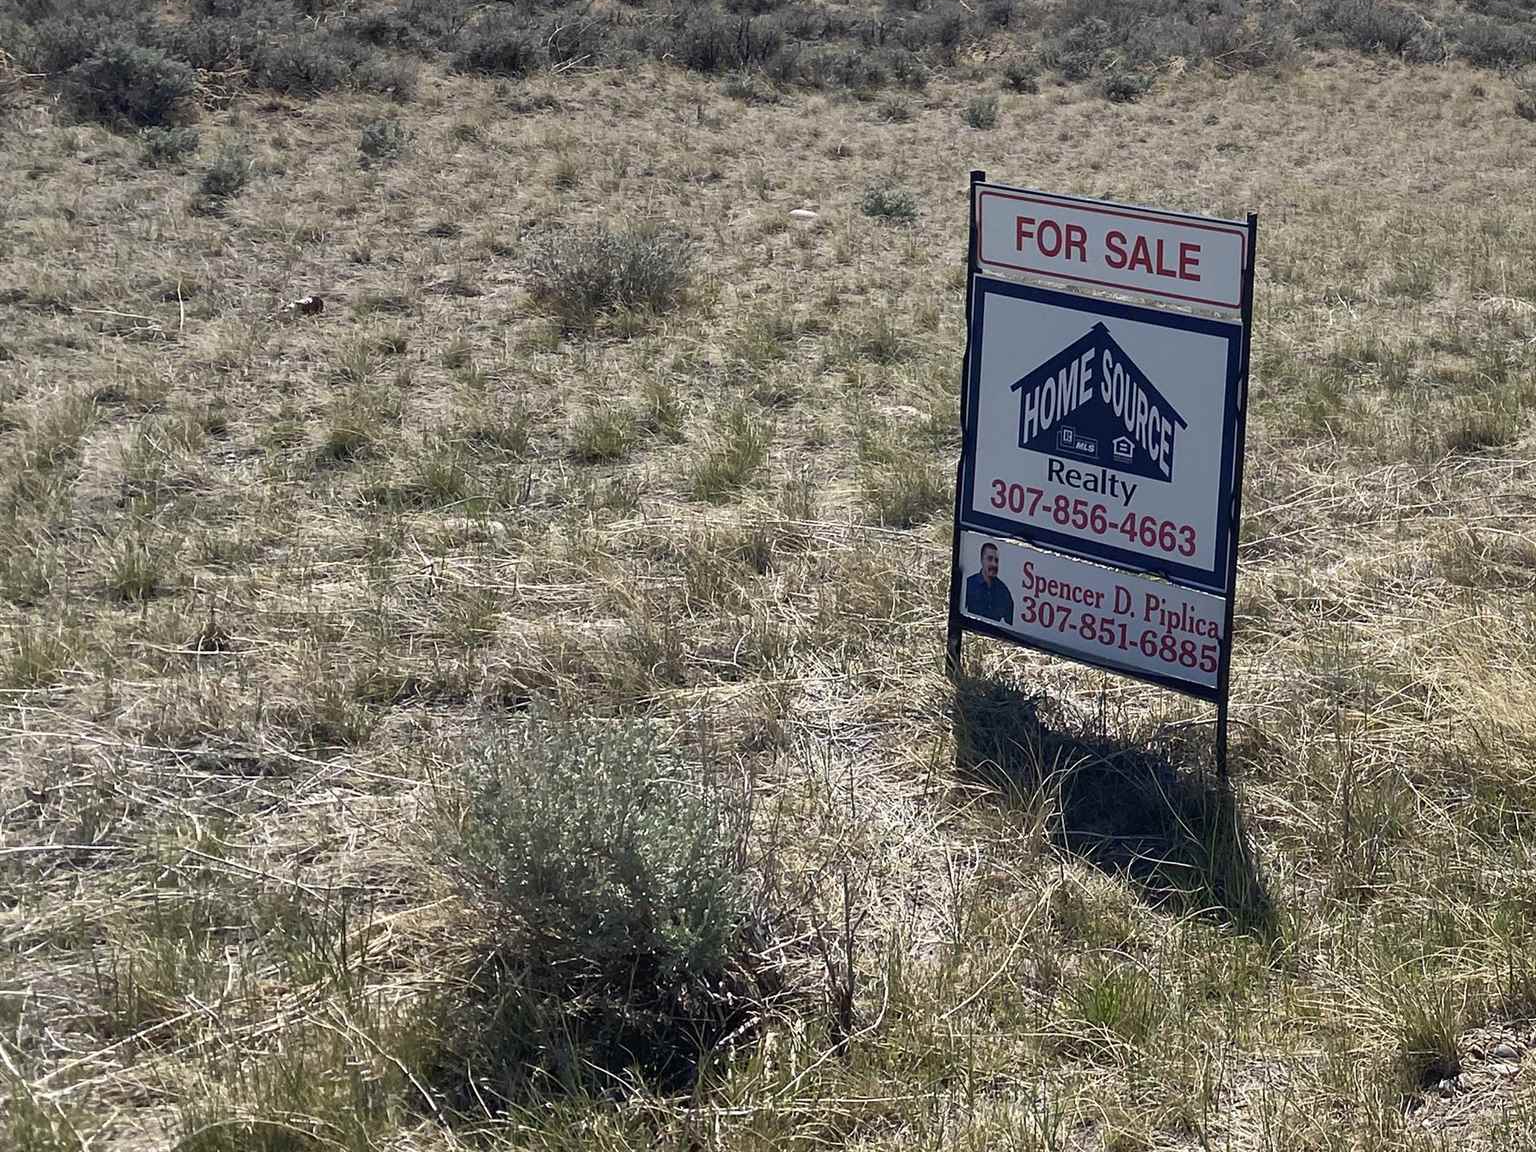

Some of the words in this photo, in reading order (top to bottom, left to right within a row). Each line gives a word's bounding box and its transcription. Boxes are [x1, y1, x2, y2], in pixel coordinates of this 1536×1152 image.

[1016, 215, 1088, 263] FOR
[1104, 230, 1201, 282] SALE
[1023, 347, 1096, 444] HOME
[1100, 349, 1173, 478] SOURCE
[1075, 440, 1096, 453] MLS
[990, 479, 1197, 558] 307-856-4663
[1047, 457, 1137, 507] Realty
[1020, 596, 1218, 674] 307-851-6885
[1021, 560, 1105, 610] Spencer
[1113, 584, 1135, 618] D.
[1143, 592, 1220, 639] Piplica
